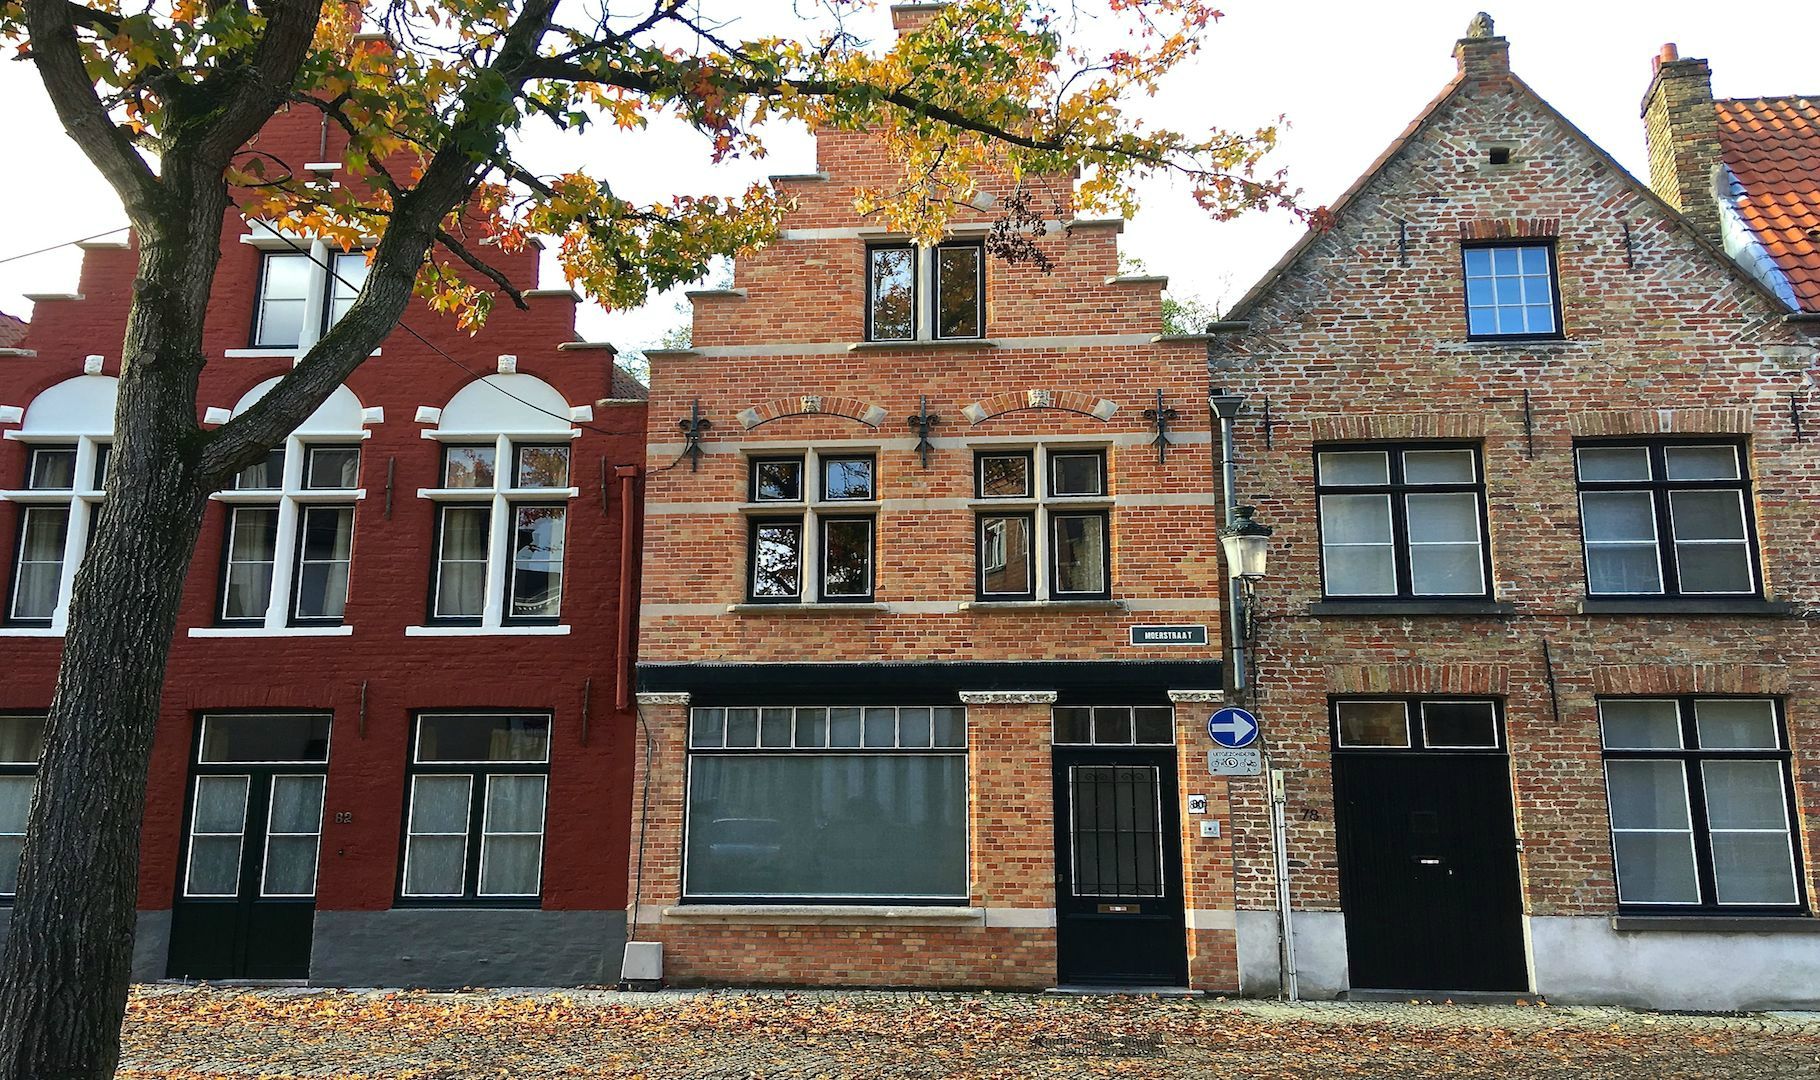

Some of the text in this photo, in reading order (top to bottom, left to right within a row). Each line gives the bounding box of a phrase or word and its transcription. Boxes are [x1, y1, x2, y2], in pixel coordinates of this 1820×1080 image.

[1144, 631, 1193, 640] MOERSTRAAT
[335, 811, 352, 824] 82
[1300, 808, 1319, 821] 78
